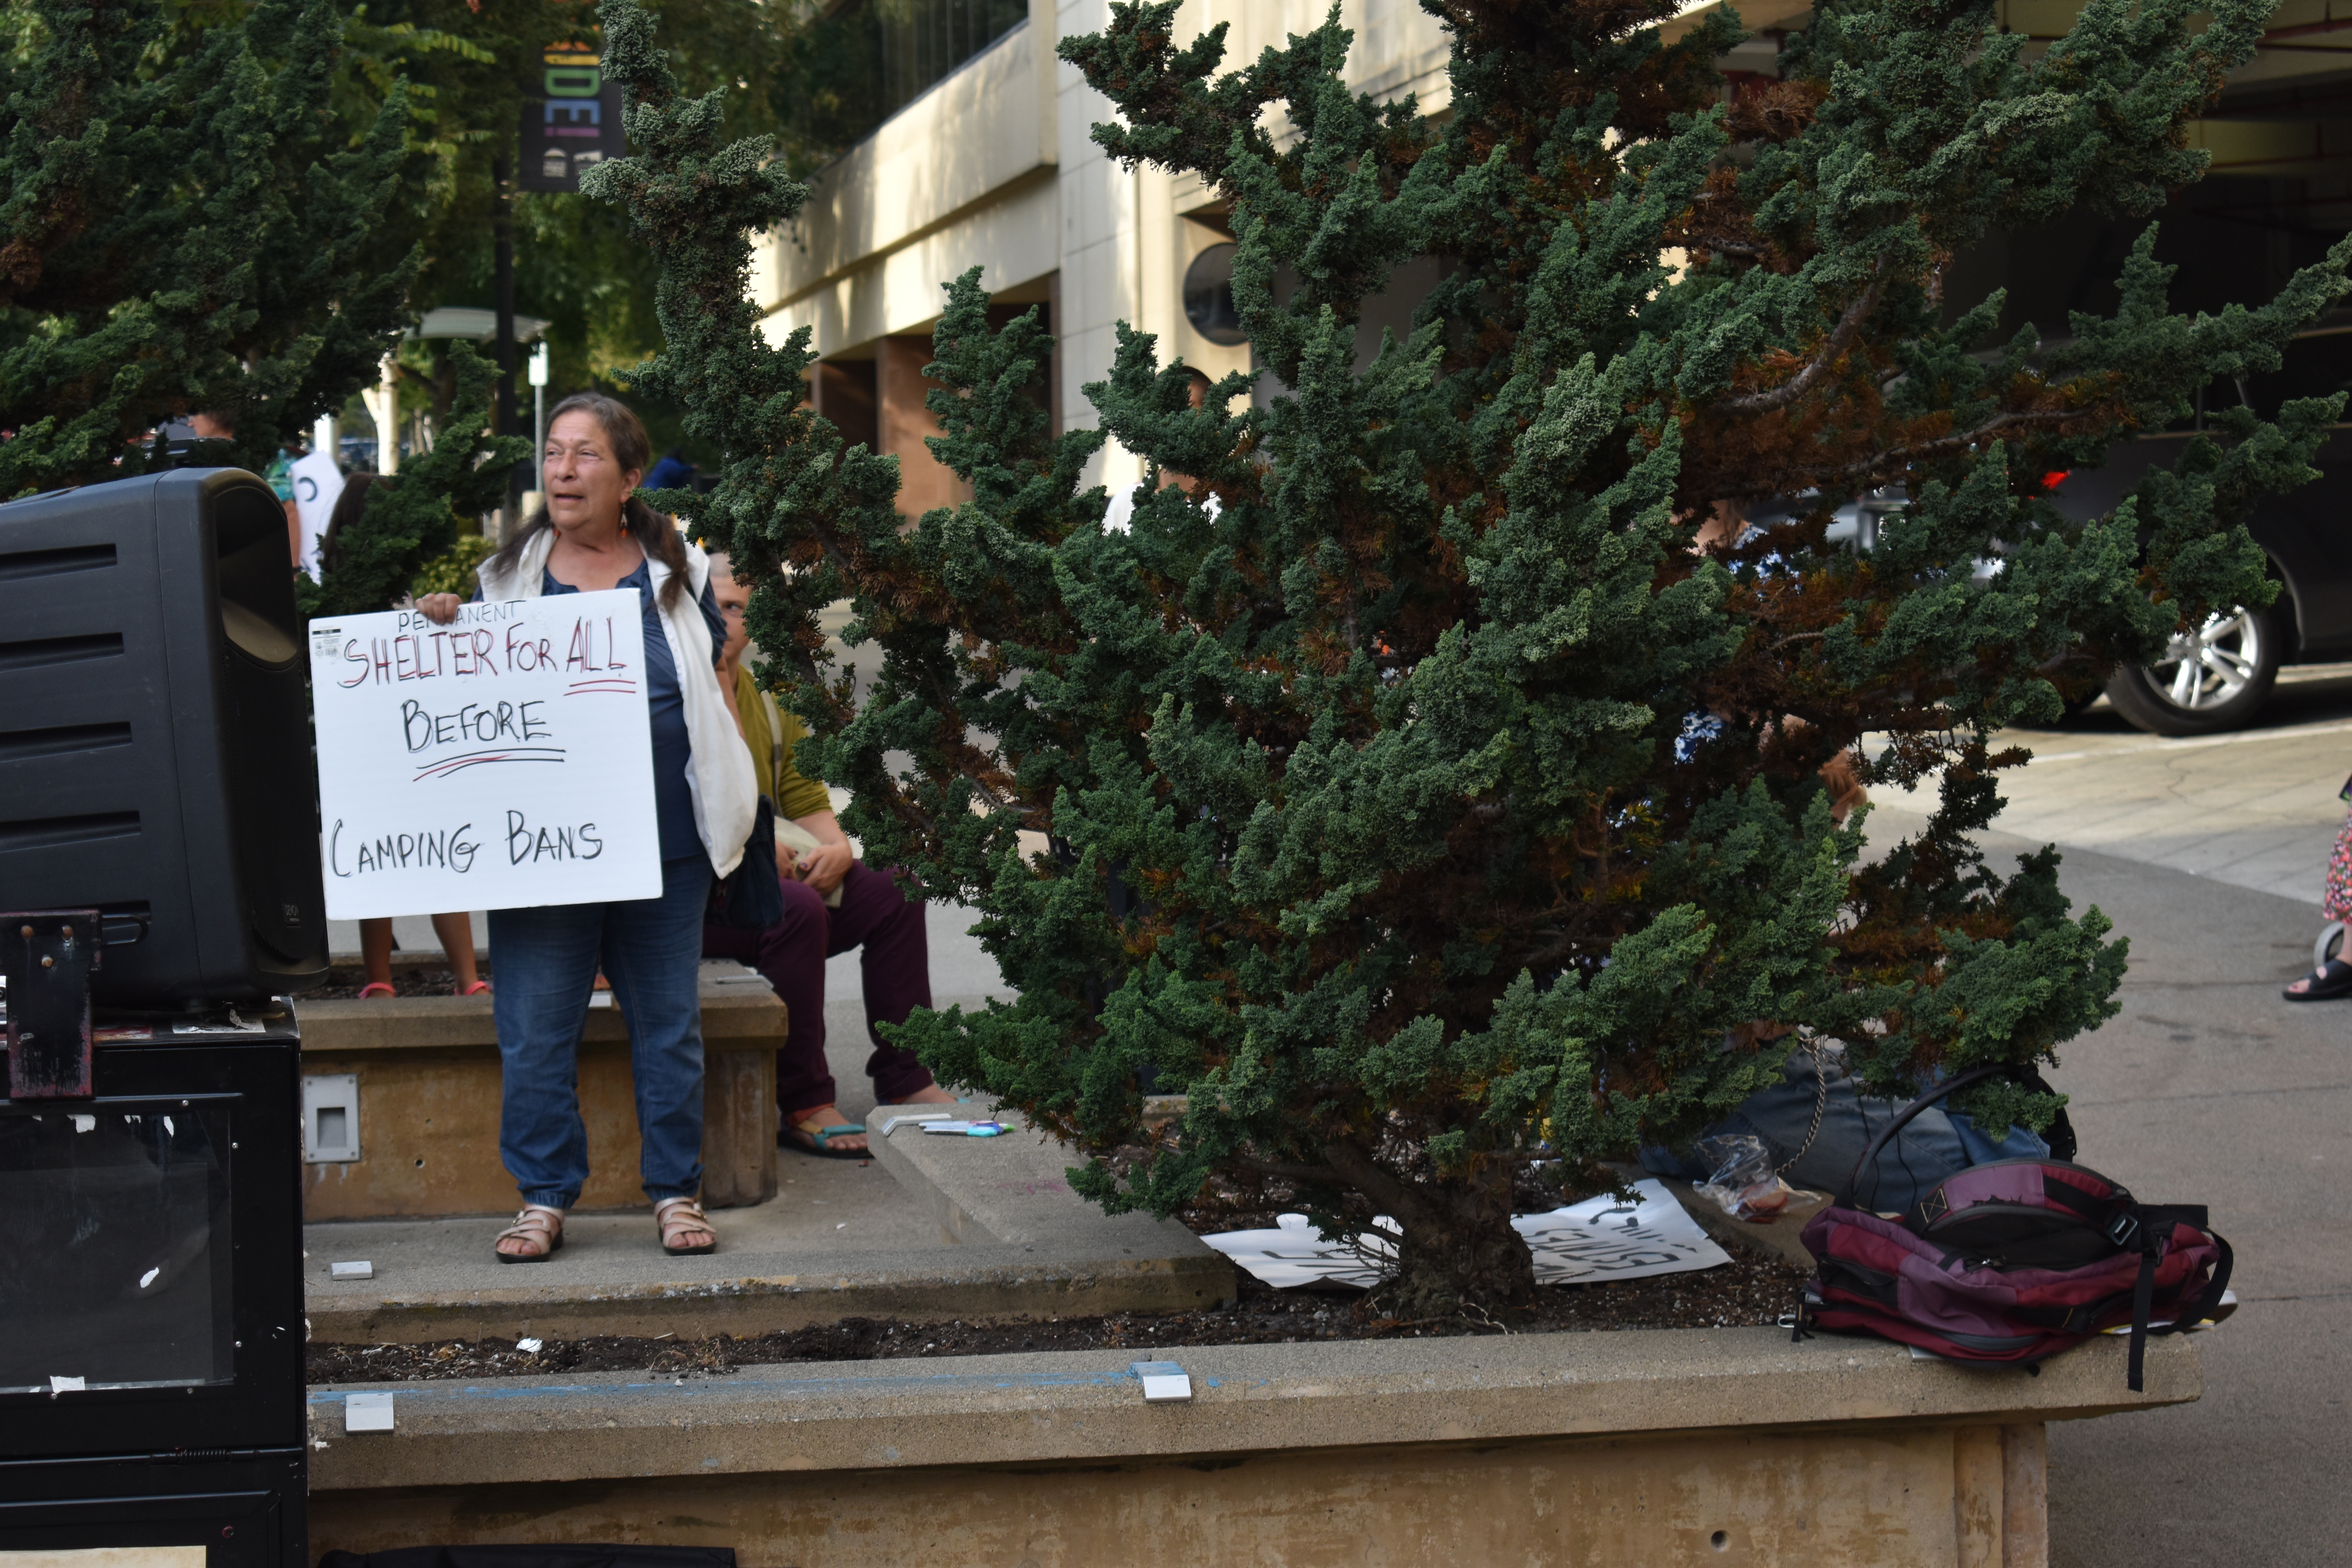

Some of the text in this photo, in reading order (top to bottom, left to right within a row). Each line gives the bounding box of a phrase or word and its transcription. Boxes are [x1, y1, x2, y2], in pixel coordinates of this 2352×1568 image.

[398, 600, 526, 633] PEANENT
[337, 616, 627, 688] SHELTER FOR ALL
[400, 699, 552, 752] BEFORE
[329, 810, 603, 877] CAMPING BANS
